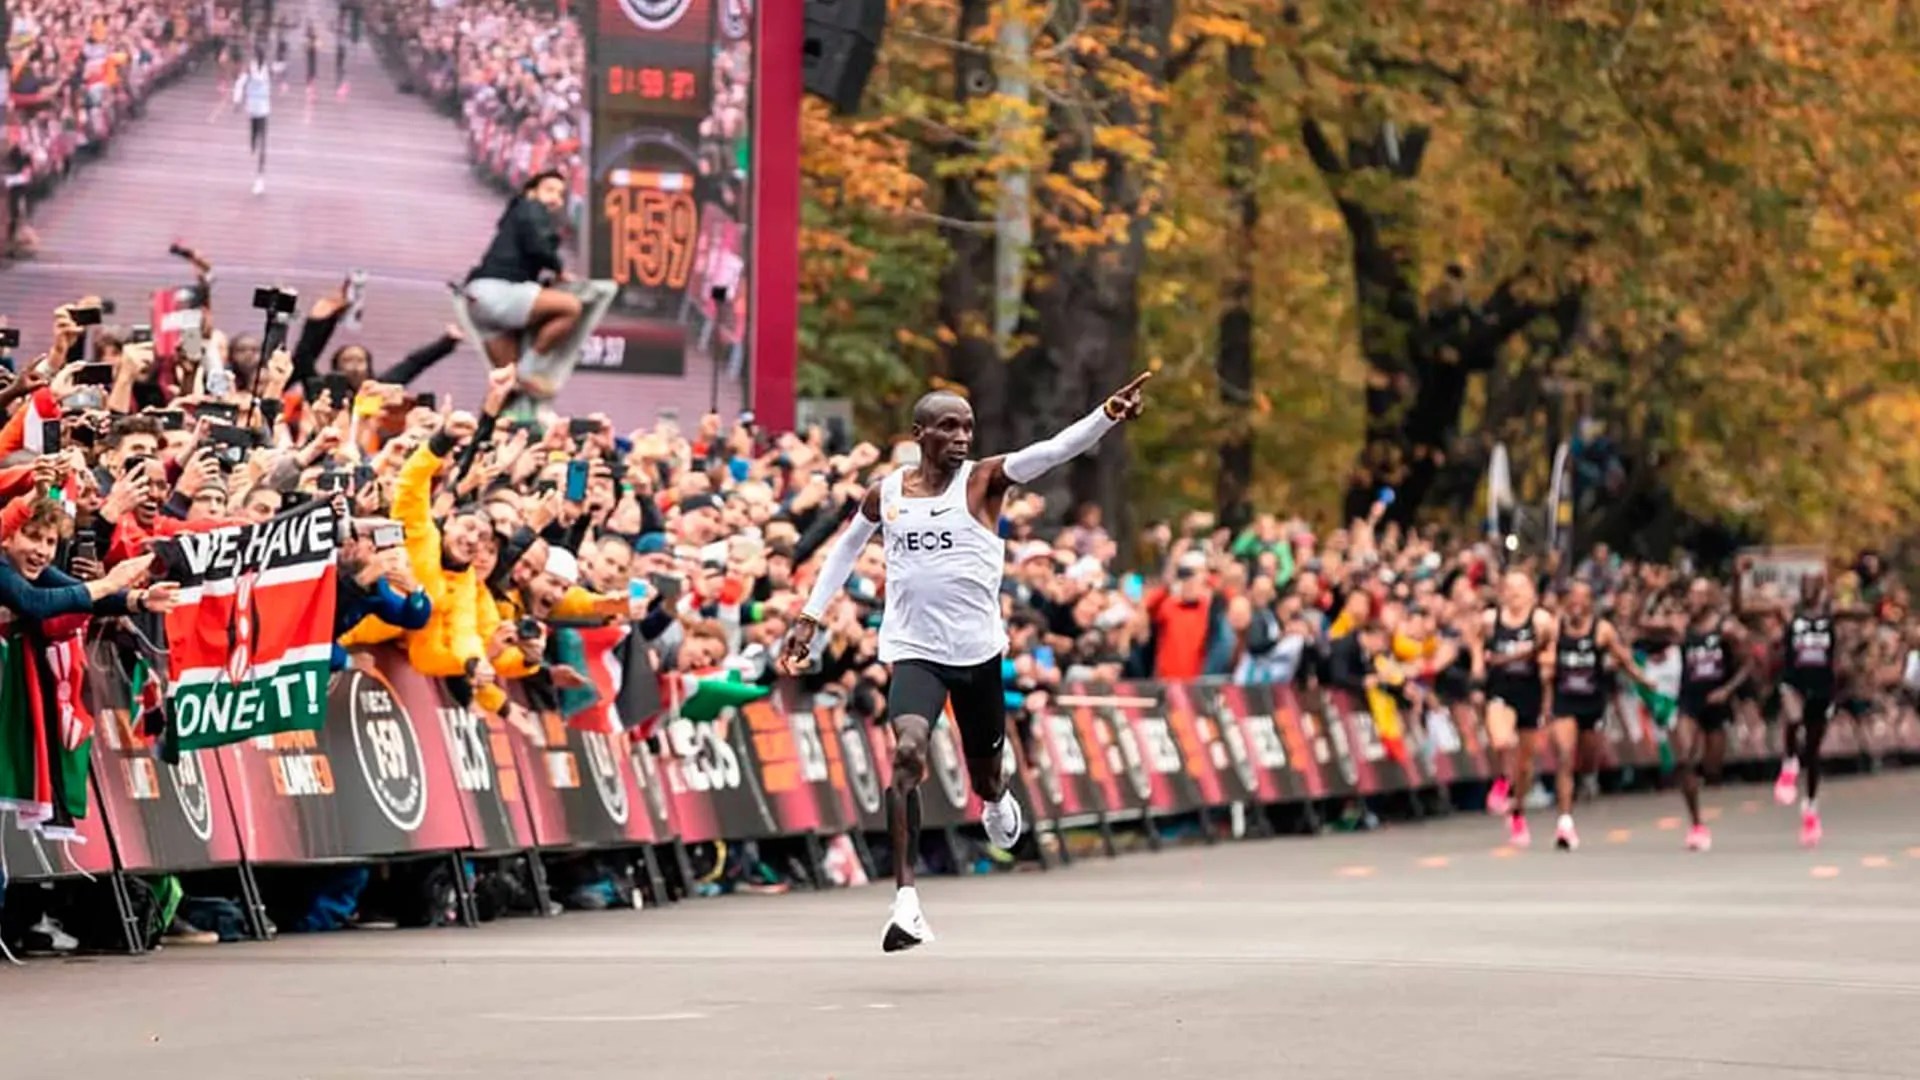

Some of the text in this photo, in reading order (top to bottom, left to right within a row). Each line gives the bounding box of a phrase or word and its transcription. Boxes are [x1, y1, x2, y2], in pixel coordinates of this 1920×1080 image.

[605, 187, 698, 289] 1:59
[179, 507, 334, 574] WE HAVE
[174, 687, 260, 737] ONE
